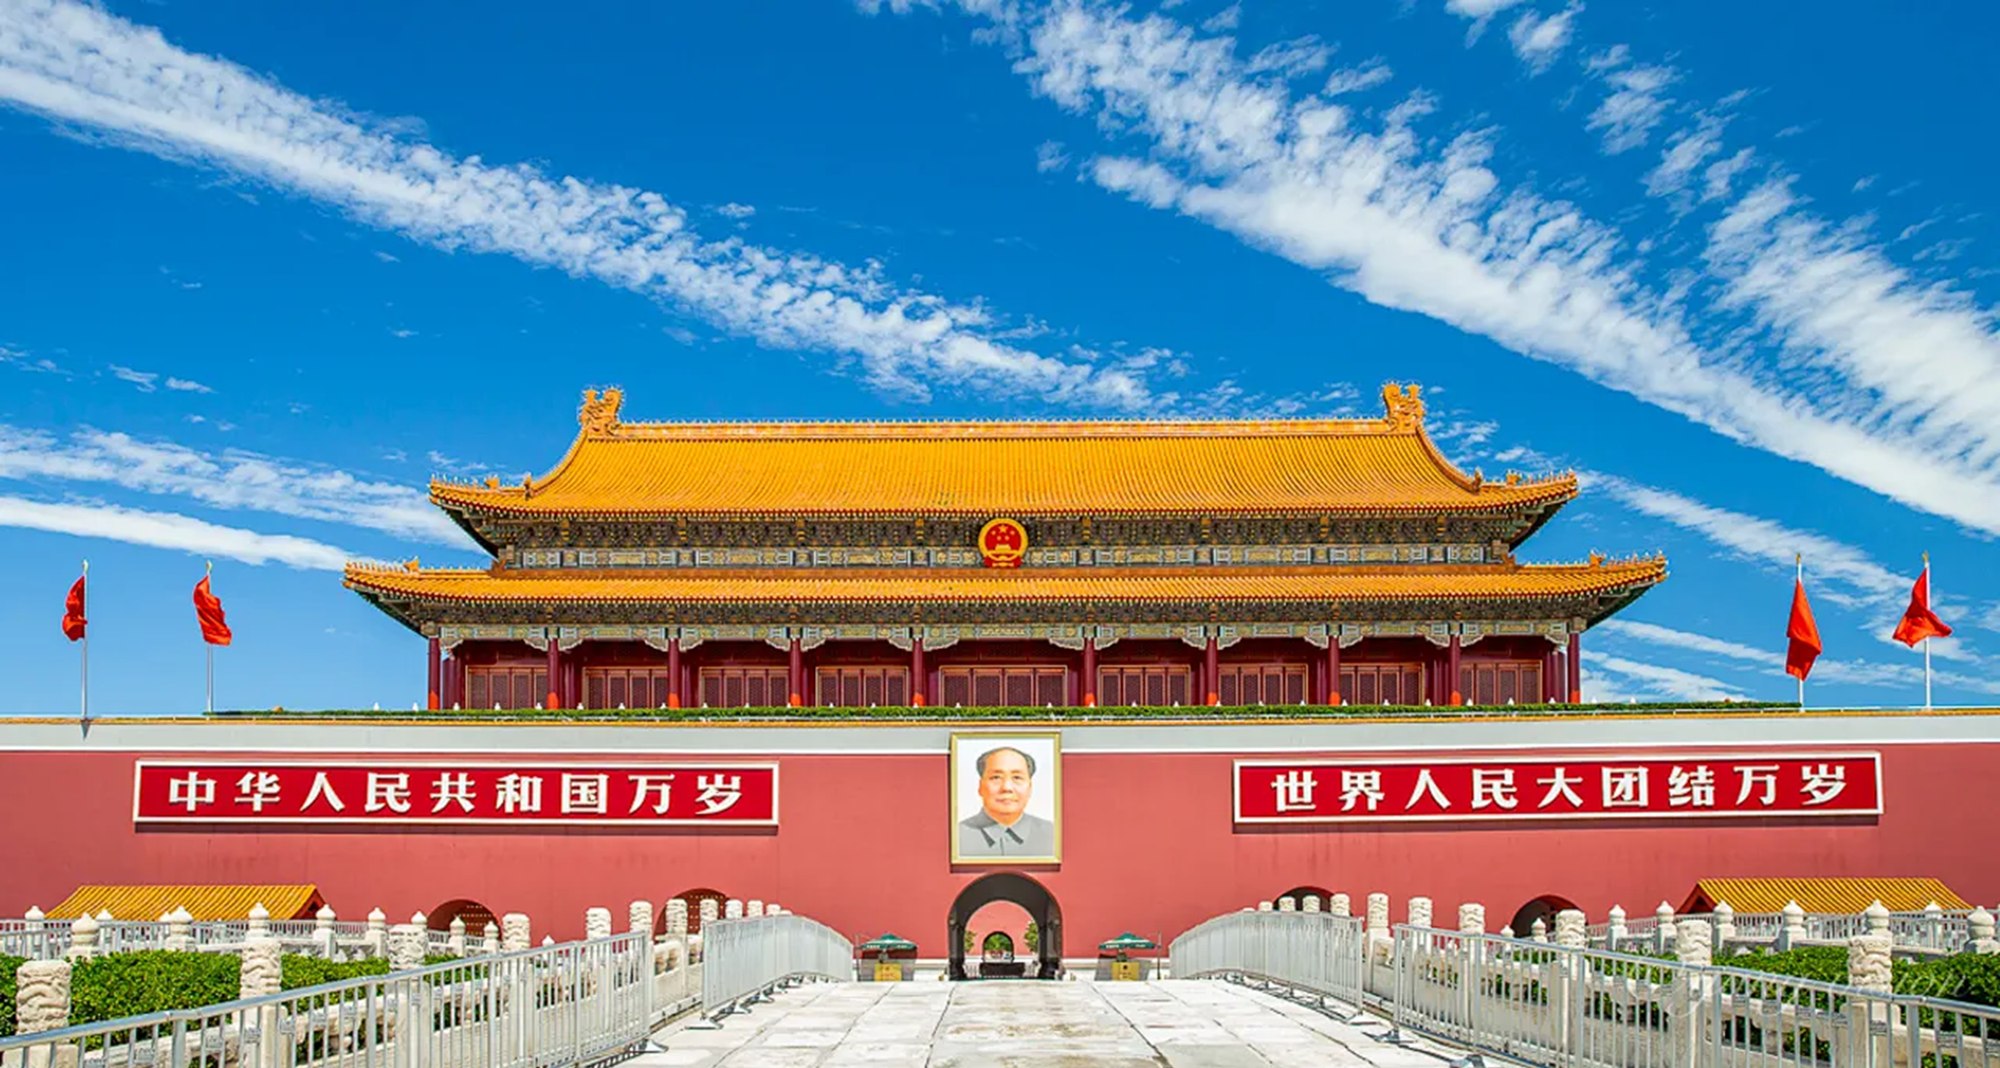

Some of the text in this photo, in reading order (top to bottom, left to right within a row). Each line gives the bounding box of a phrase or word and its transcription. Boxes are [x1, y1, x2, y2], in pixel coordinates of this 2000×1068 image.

[169, 771, 742, 814] 中华人民共和国万岁
[1270, 764, 1846, 811] 世界人民大团结万岁
